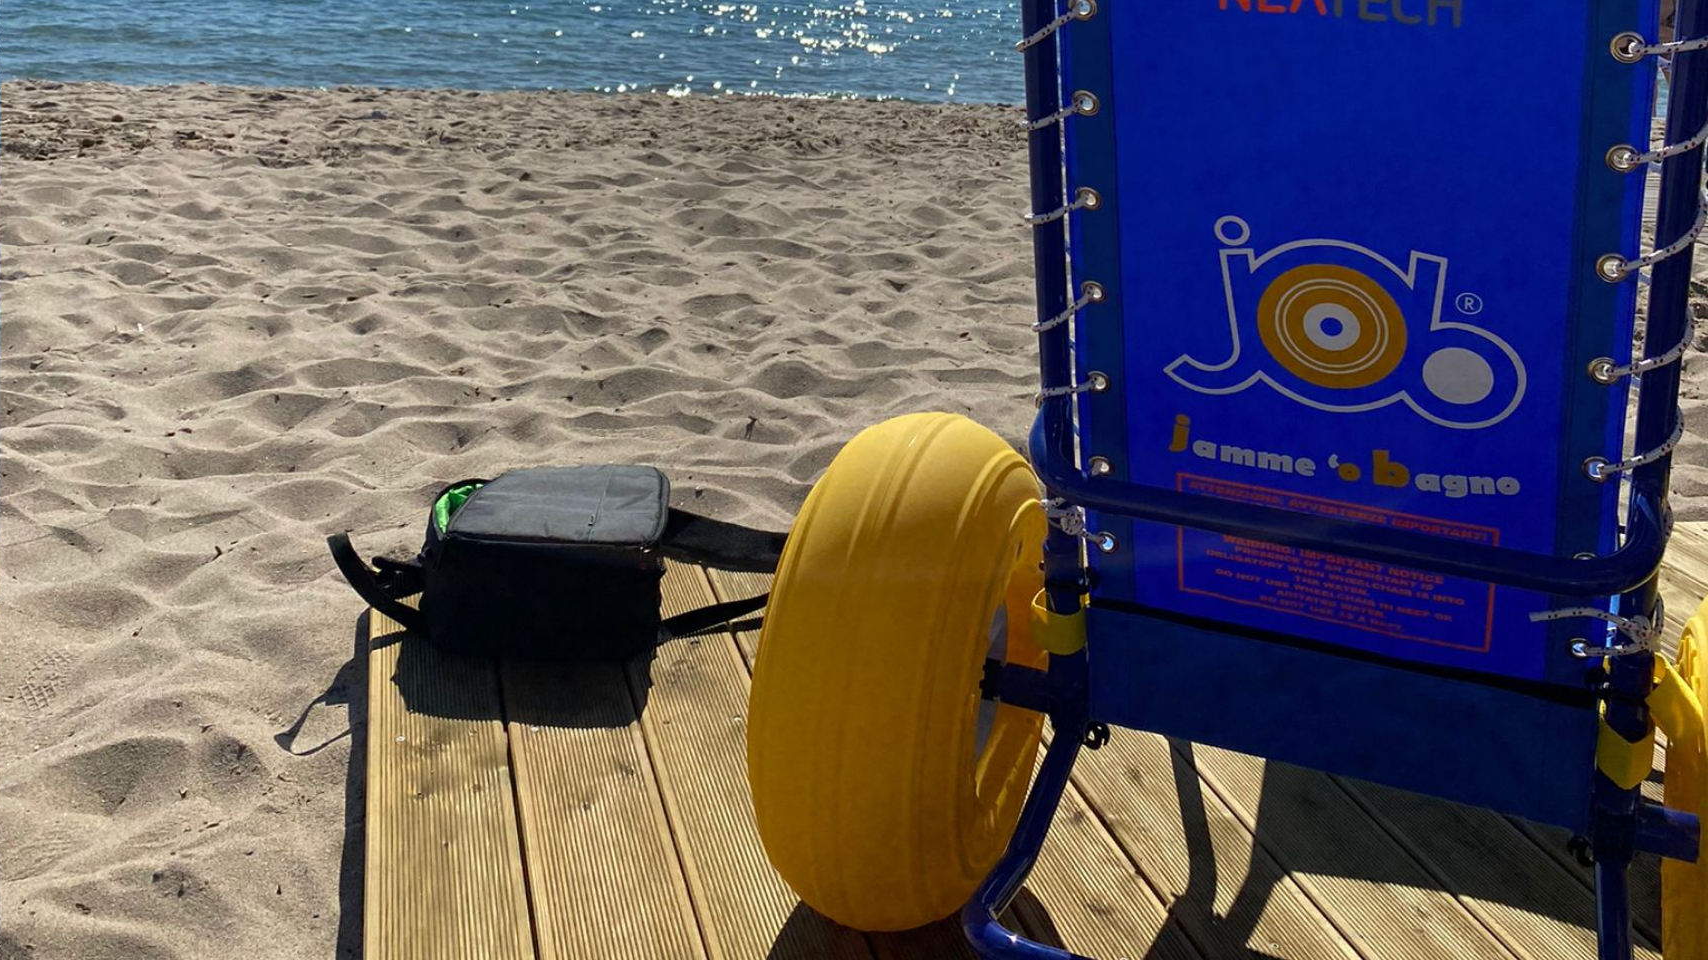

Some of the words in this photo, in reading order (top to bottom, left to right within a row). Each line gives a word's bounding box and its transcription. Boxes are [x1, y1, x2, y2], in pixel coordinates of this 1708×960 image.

[1169, 414, 1316, 477] jamme
[1372, 449, 1521, 497] bagno
[1388, 567, 1444, 585] NOTICE
